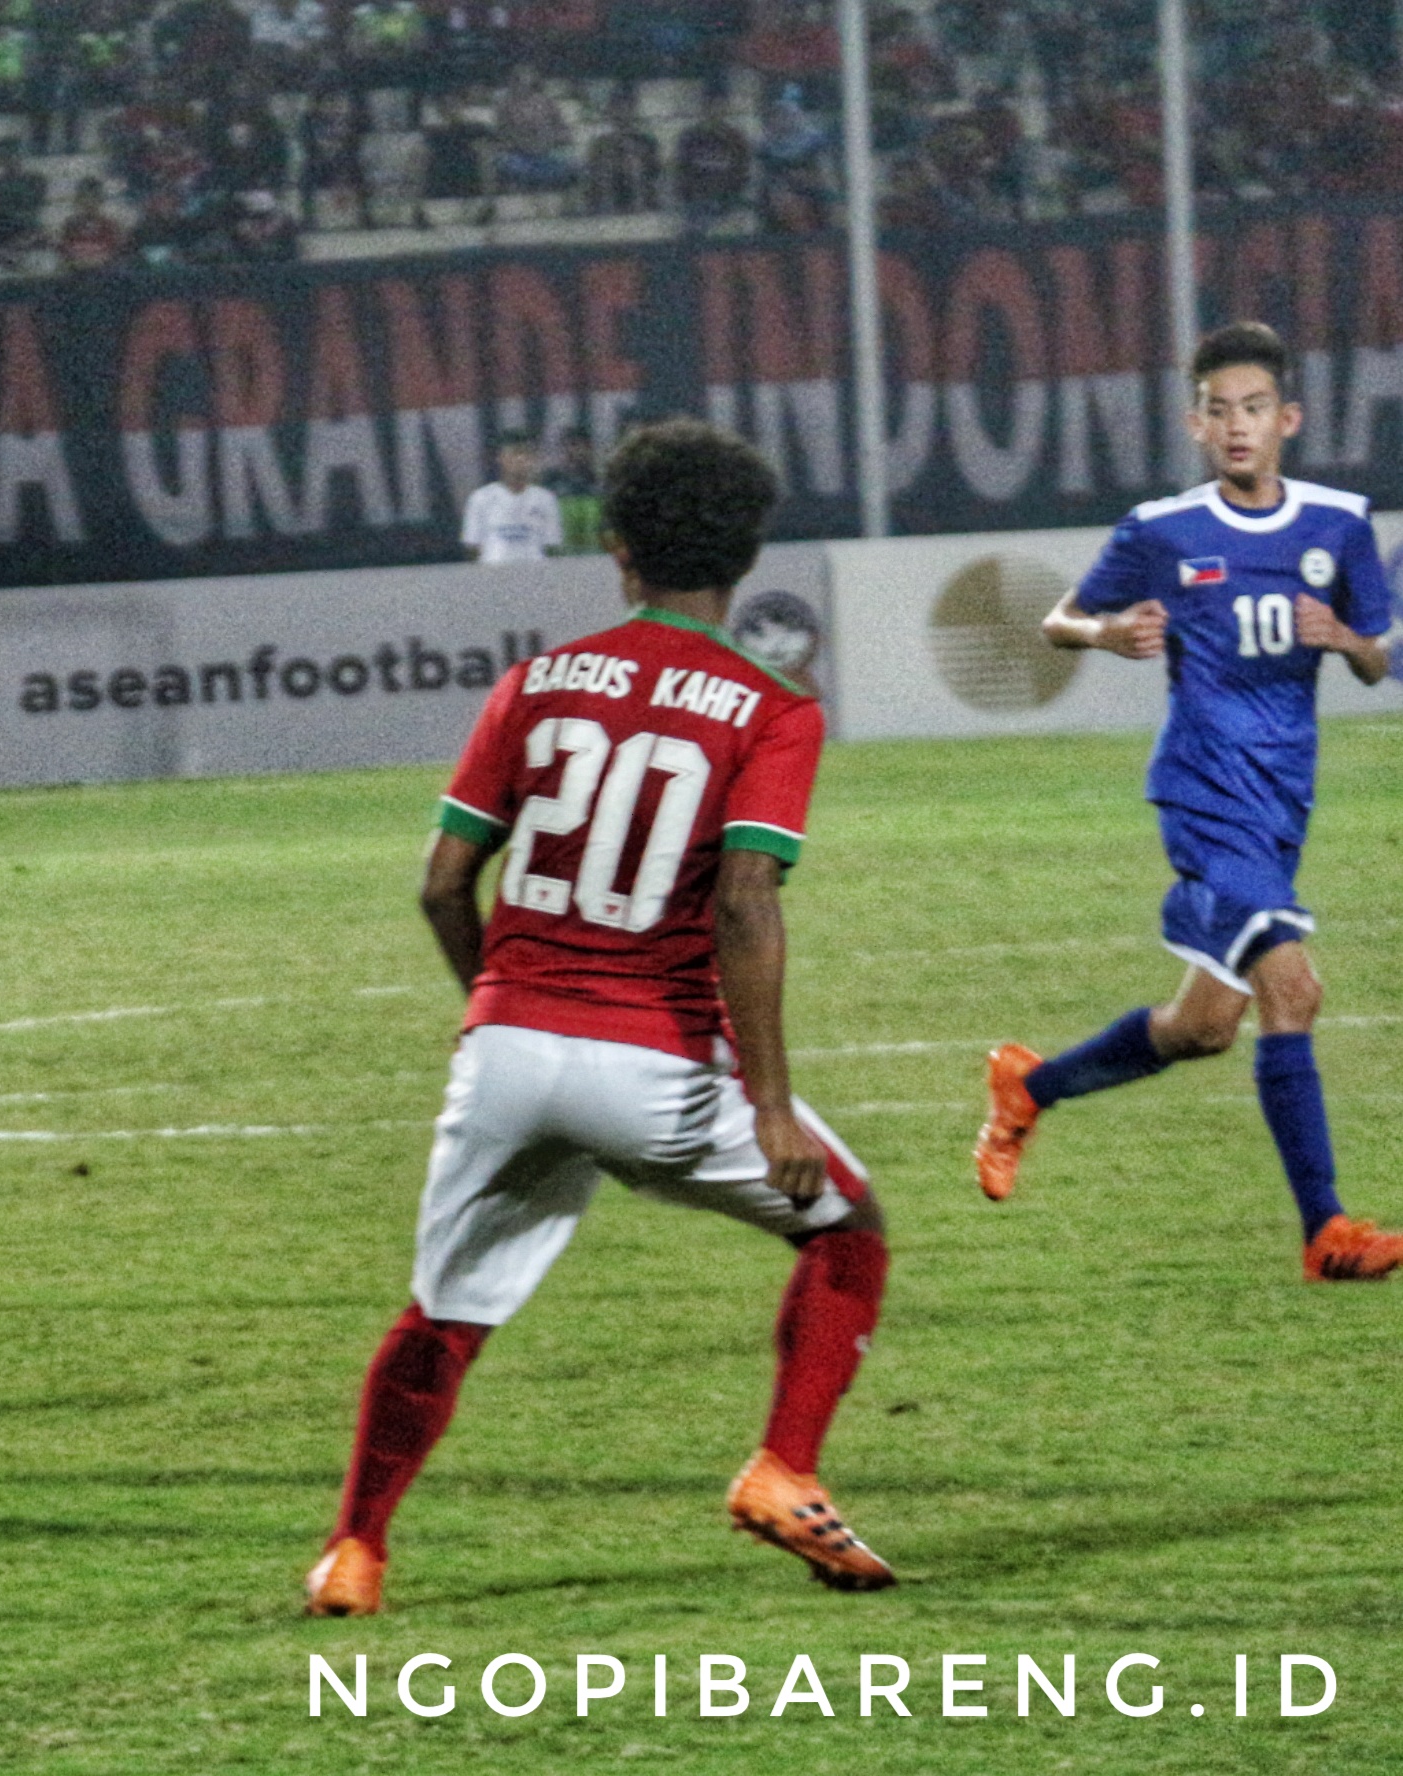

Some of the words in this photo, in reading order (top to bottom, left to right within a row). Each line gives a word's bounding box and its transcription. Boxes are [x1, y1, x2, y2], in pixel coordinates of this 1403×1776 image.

[114, 260, 644, 545] GRANDE
[522, 652, 640, 699] BAGUS
[650, 667, 762, 728] KAHFI
[1233, 594, 1294, 658] 10
[502, 717, 712, 933] 20
